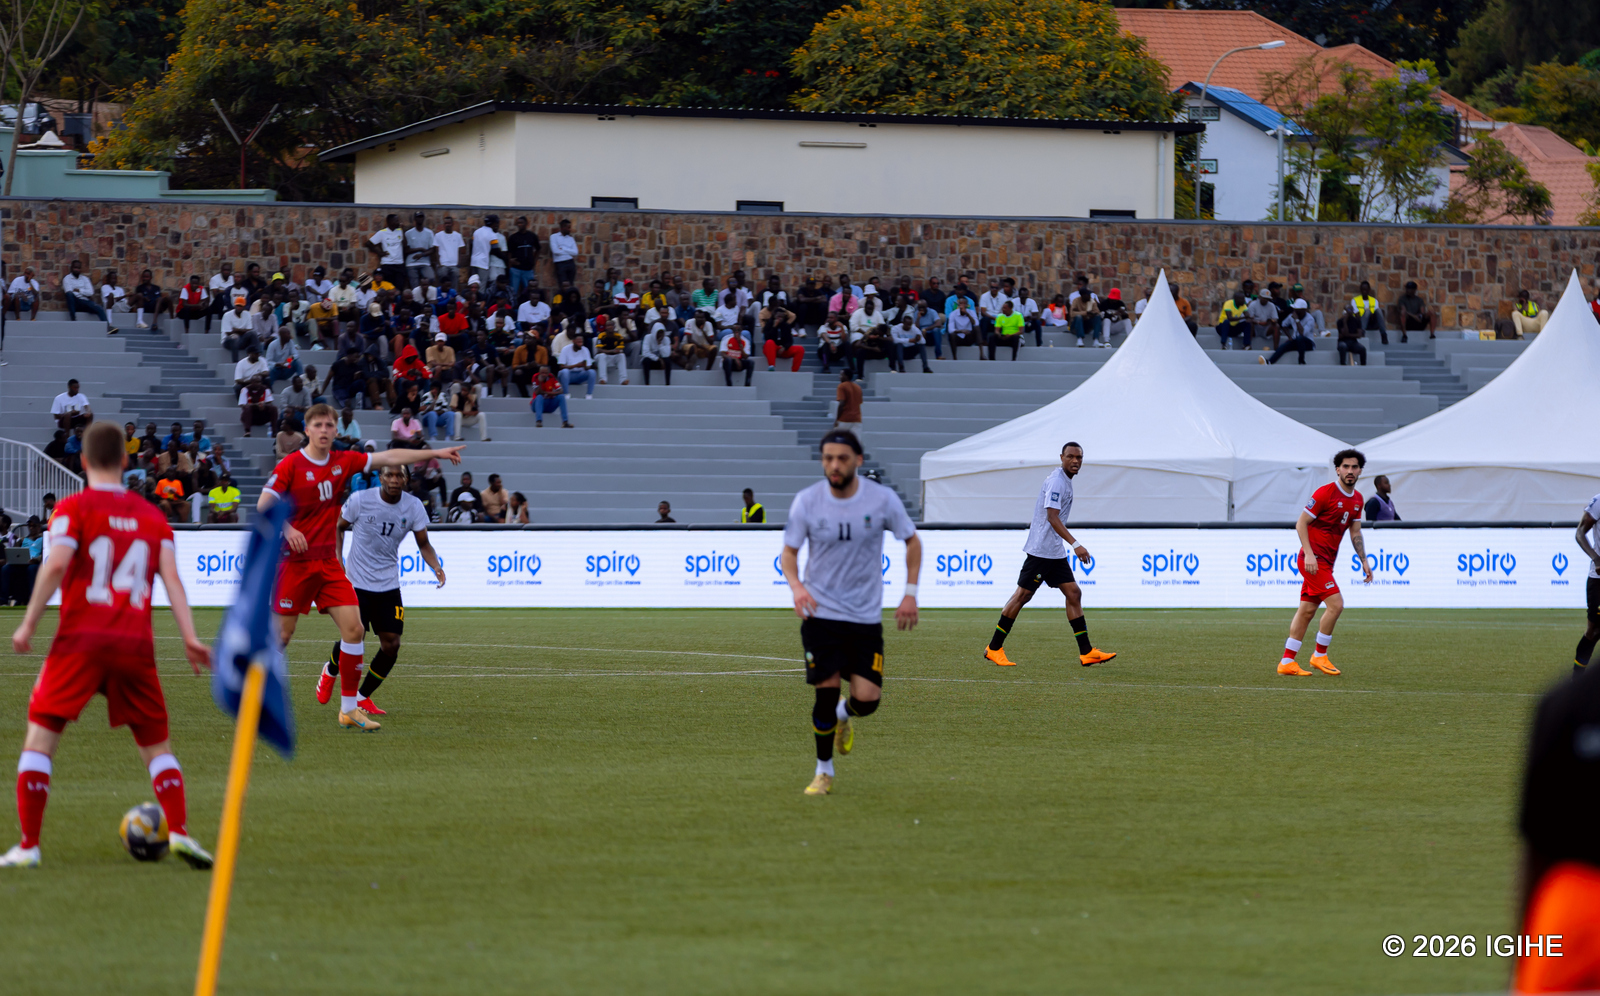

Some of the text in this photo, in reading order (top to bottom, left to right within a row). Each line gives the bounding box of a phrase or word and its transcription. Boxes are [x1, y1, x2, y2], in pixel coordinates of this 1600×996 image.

[318, 480, 333, 501] 10
[1341, 511, 1349, 525] 9
[381, 522, 395, 537] 17
[838, 523, 852, 541] 11
[85, 535, 151, 610] 14
[487, 550, 542, 577] spiro
[586, 550, 640, 577] spiro
[685, 550, 740, 577] spiro
[936, 549, 993, 577] spiro
[1142, 549, 1200, 577] spiro
[1457, 548, 1517, 577] spiro
[936, 578, 956, 587] Energy
[1141, 578, 1162, 587] Energy
[1246, 578, 1266, 587] Energy
[1457, 578, 1477, 587] Energy
